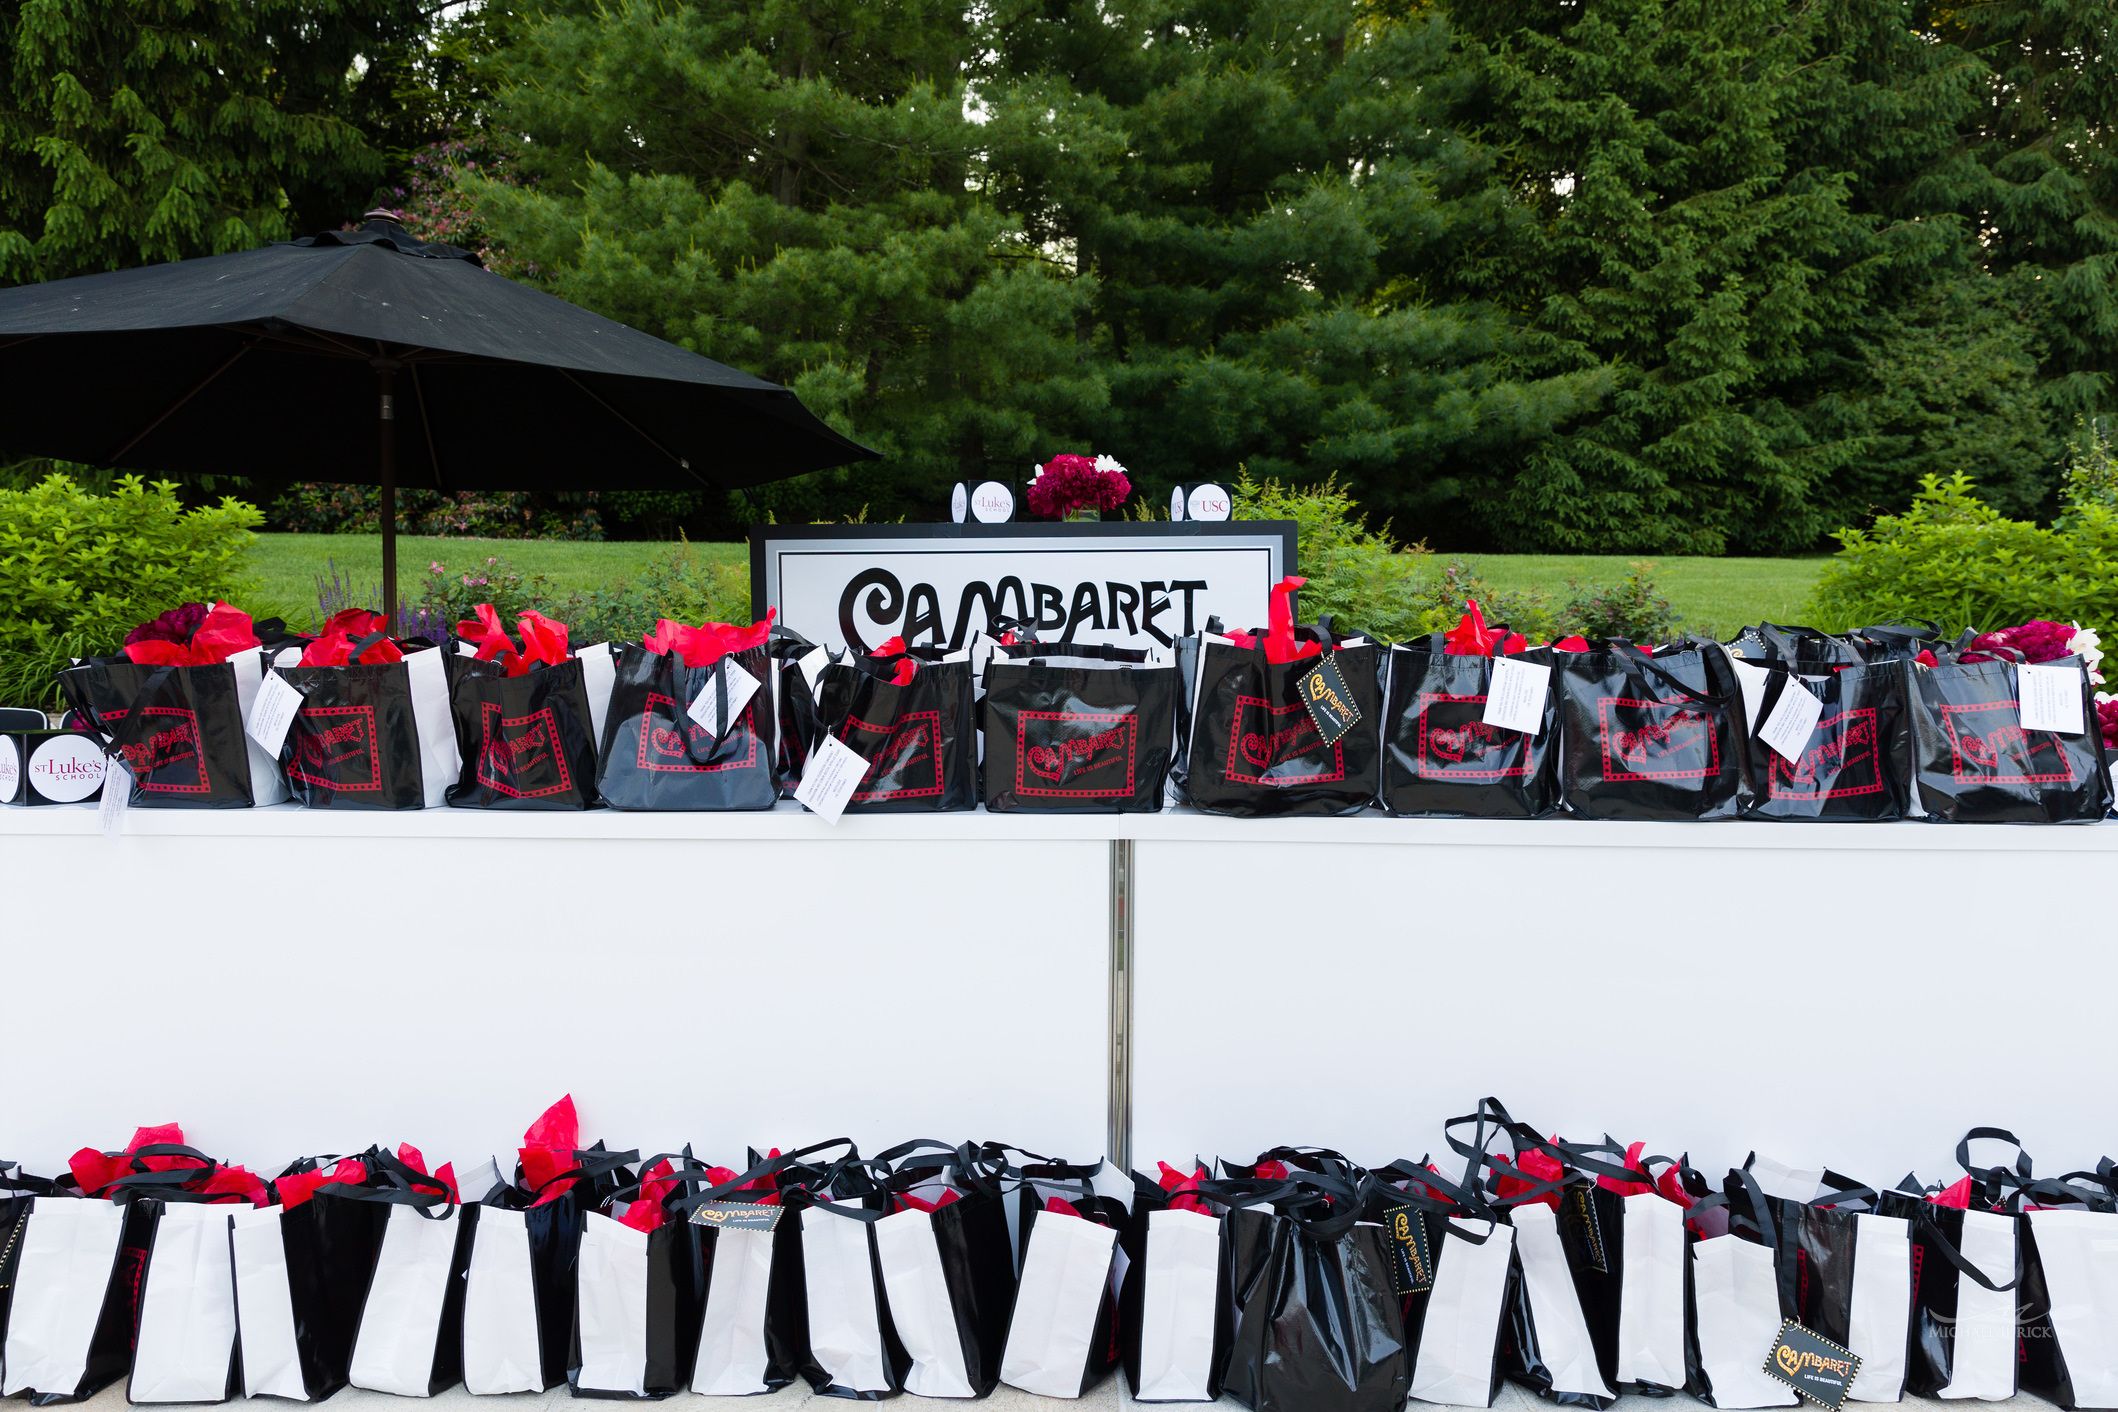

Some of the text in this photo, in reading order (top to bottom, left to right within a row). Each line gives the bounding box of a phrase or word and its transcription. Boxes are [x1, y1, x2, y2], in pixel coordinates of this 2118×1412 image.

[1202, 500, 1228, 513] USC
[838, 567, 1207, 651] CAMBARET
[0, 756, 17, 775] uke's
[34, 757, 102, 774] ST Luke's
[55, 773, 101, 781] SCHOOL
[1776, 1344, 1852, 1378] CAMBARET
[1804, 1373, 1815, 1381] LIFE
